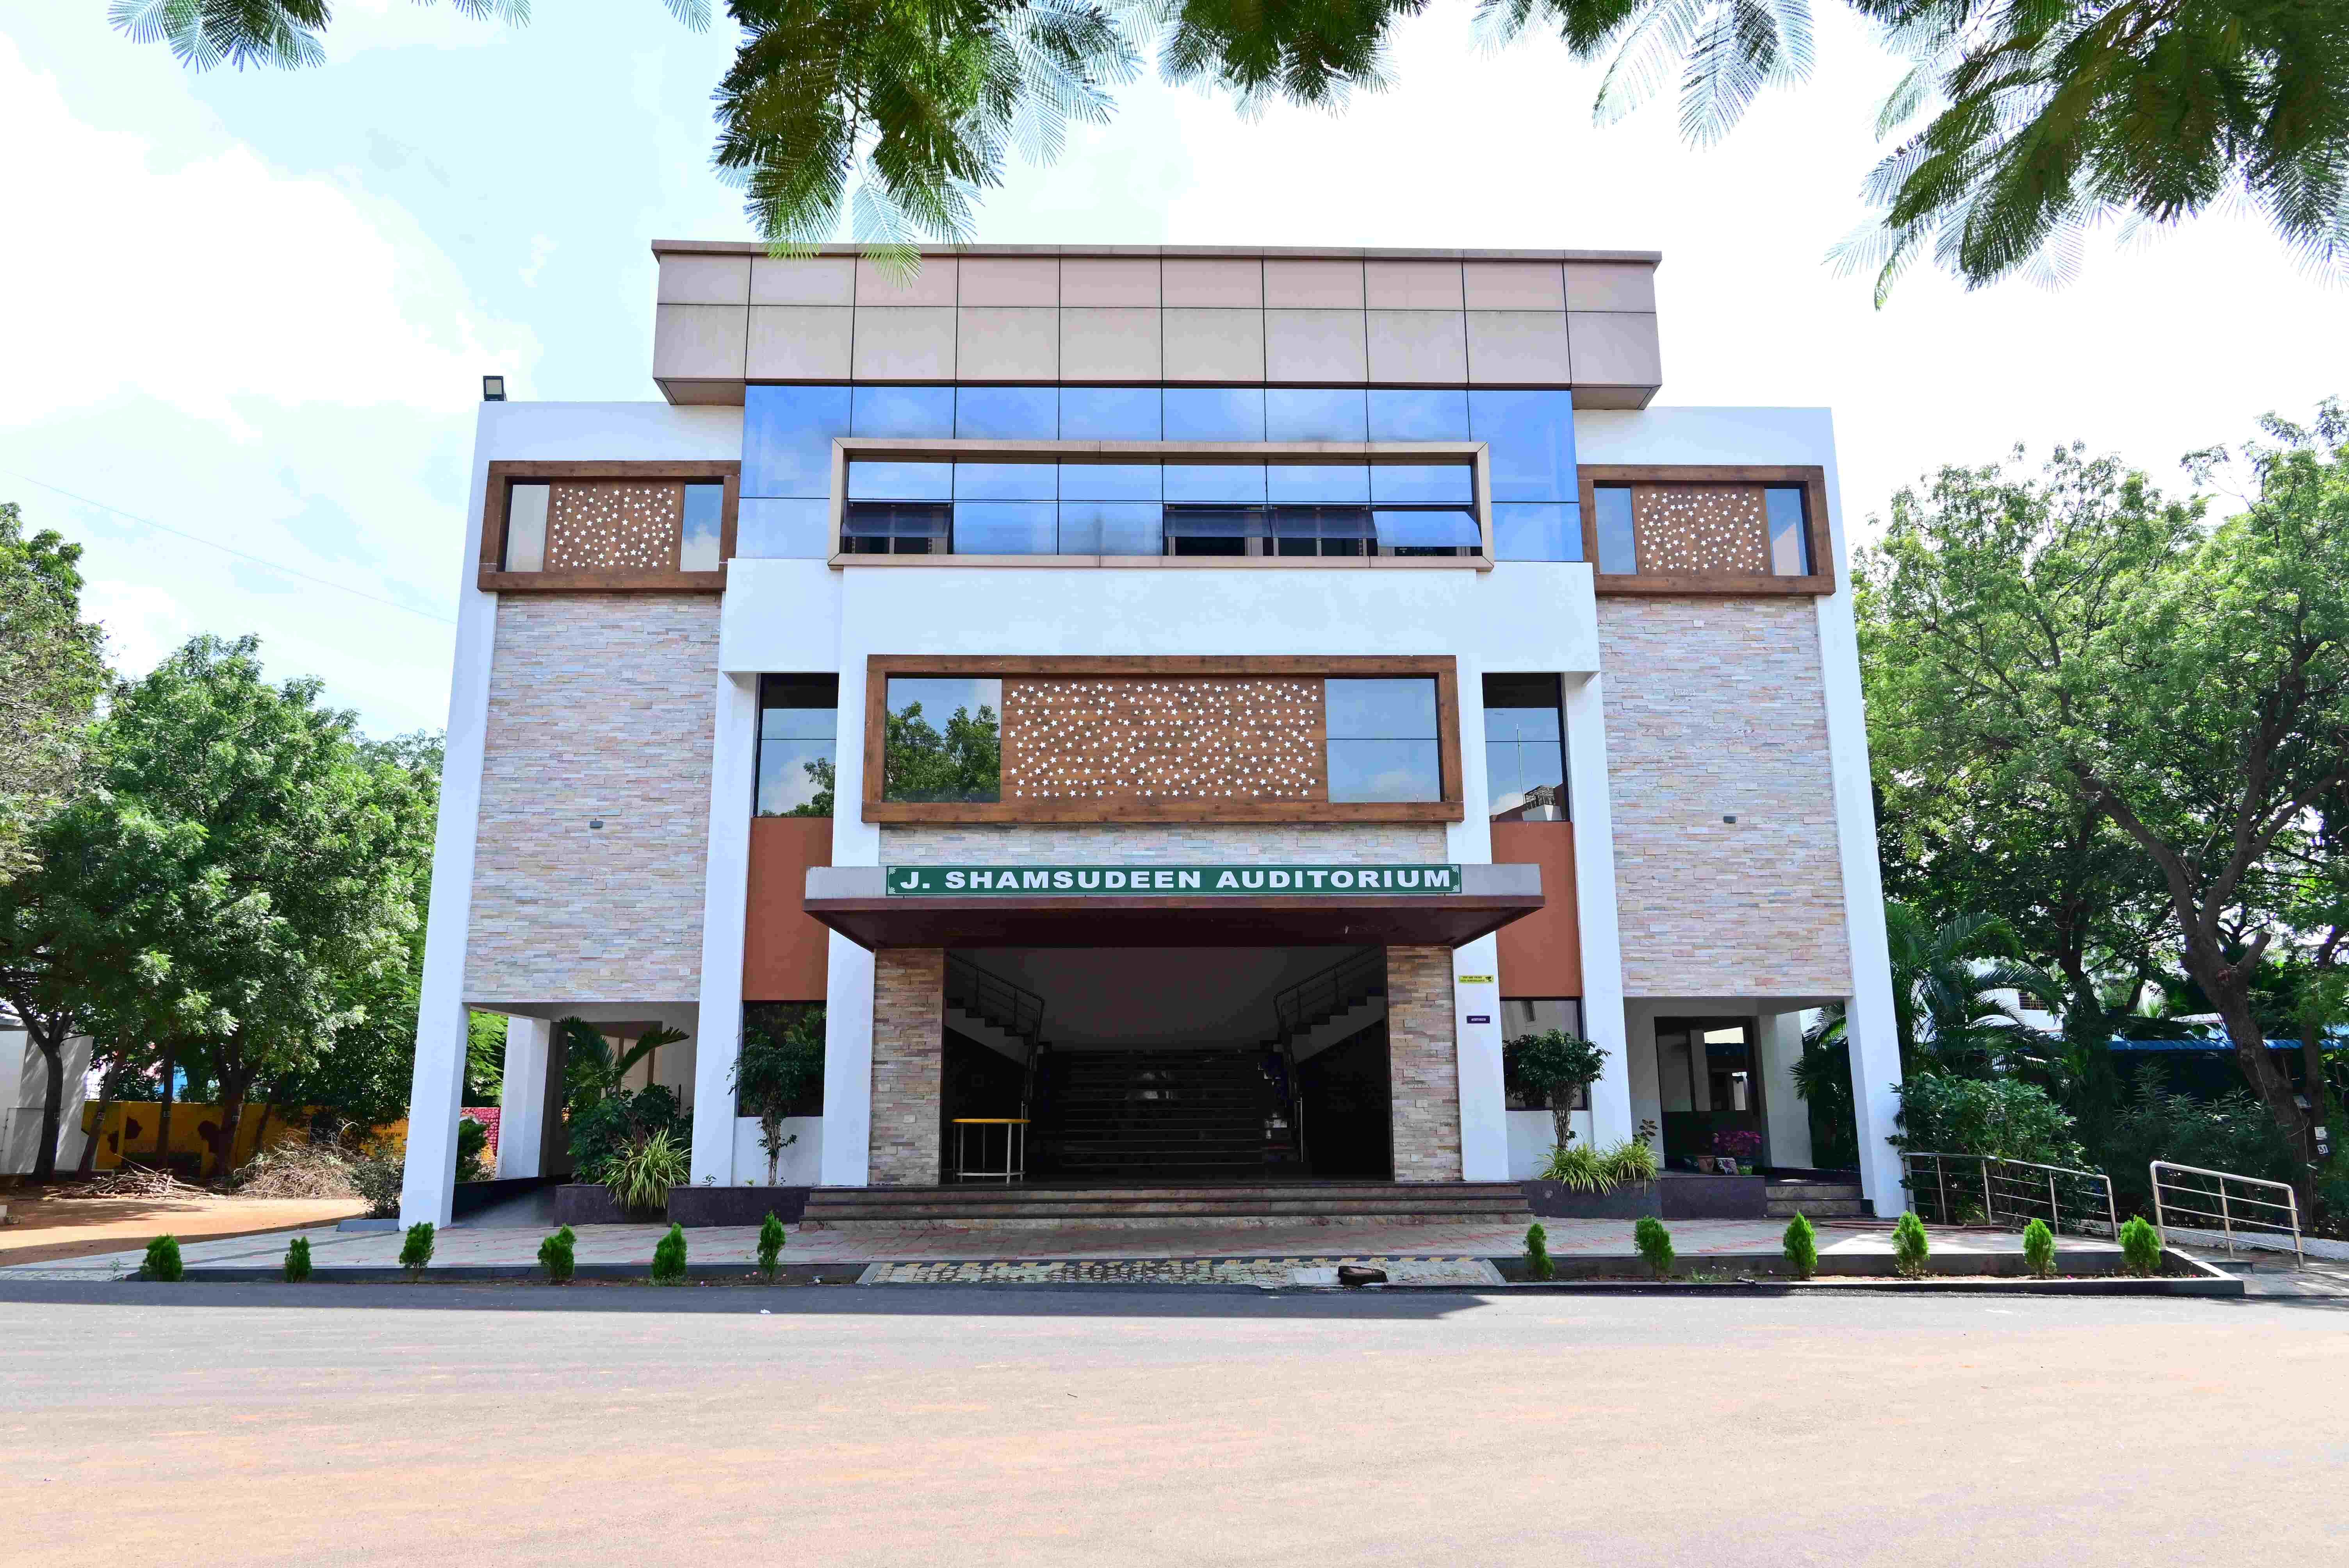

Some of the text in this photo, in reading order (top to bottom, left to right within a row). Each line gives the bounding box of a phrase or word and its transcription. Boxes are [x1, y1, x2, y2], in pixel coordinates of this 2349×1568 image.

[900, 870, 1450, 889] J. SHAMSUDEEN AUDITORIUM
